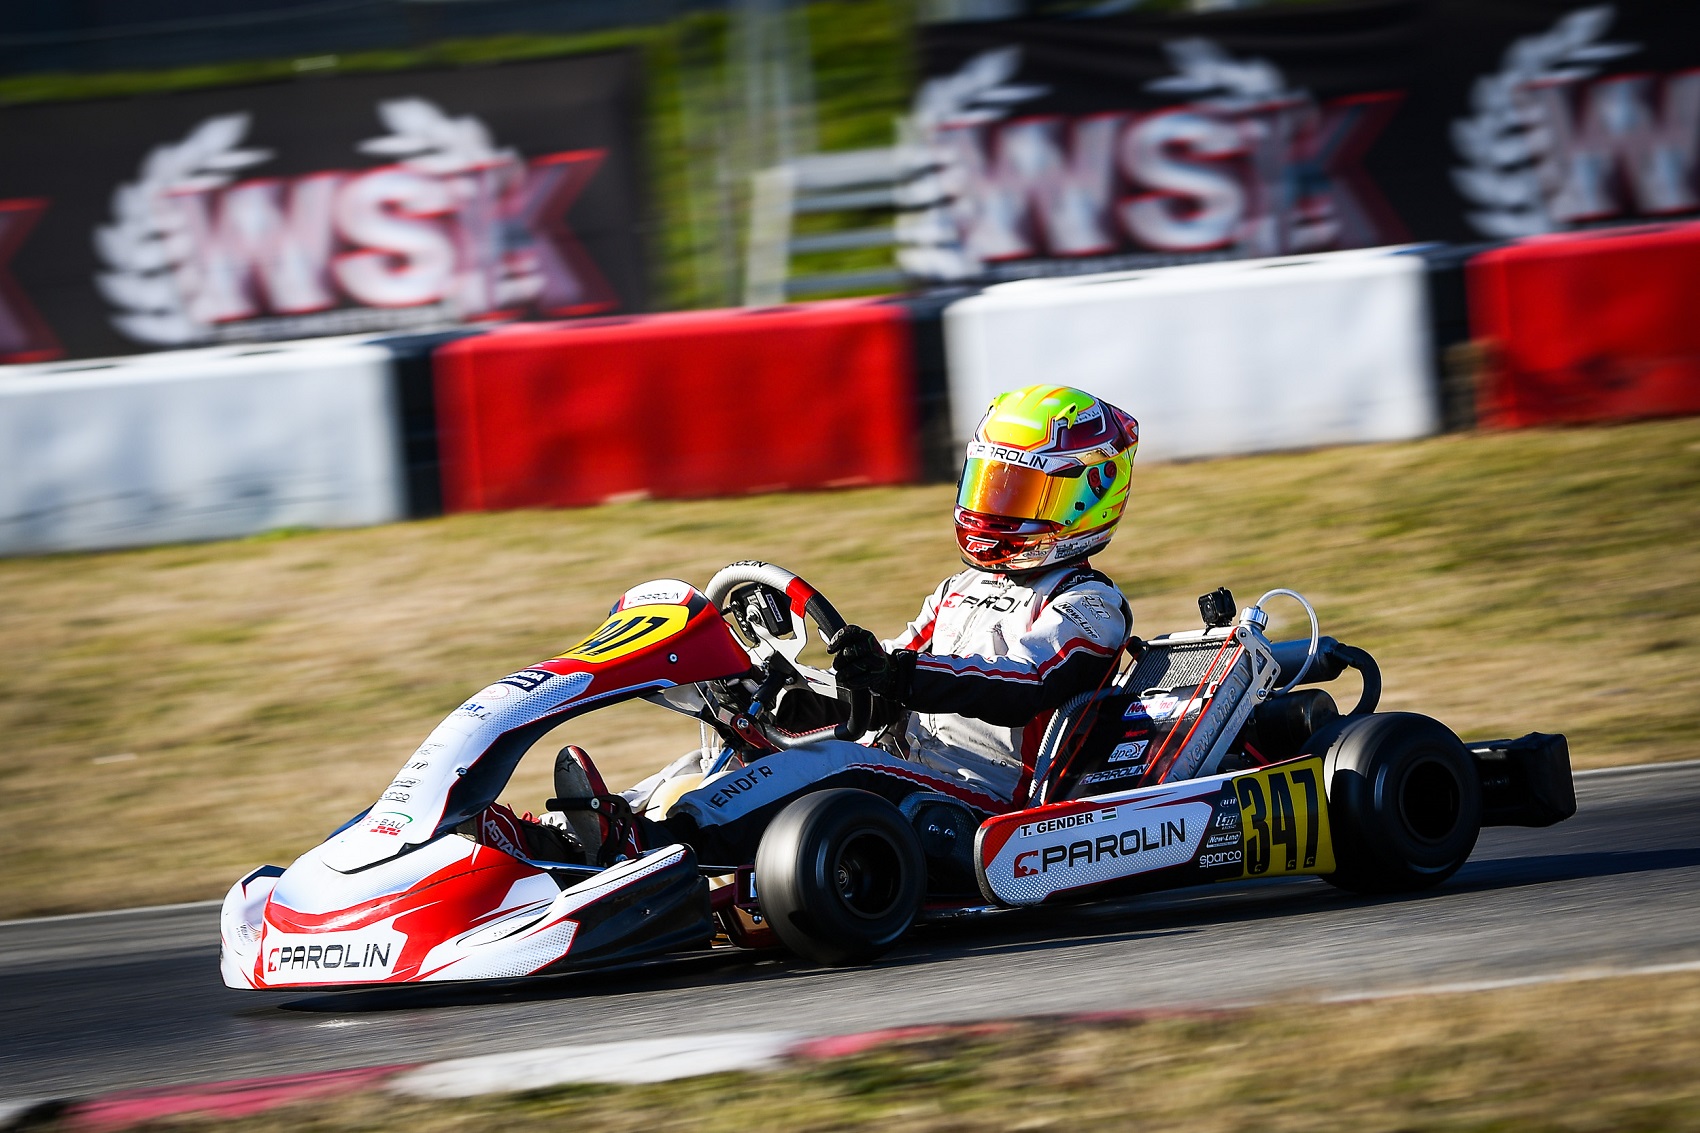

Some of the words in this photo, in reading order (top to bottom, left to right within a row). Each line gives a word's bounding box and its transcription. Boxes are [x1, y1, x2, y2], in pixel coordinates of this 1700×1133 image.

[936, 90, 1412, 260] WSK
[160, 148, 620, 323] WSK
[1058, 602, 1099, 639] New-Line
[1092, 764, 1150, 782] PAROLIN
[485, 820, 529, 860] ASTAR
[1021, 825, 1033, 837] T.
[1036, 812, 1095, 834] GENDER
[1209, 833, 1239, 844] New-Line
[1236, 768, 1319, 875] 347
[1042, 818, 1186, 873] PAROLIN
[1199, 850, 1242, 869] sparco
[279, 943, 391, 971] PAROLIN
